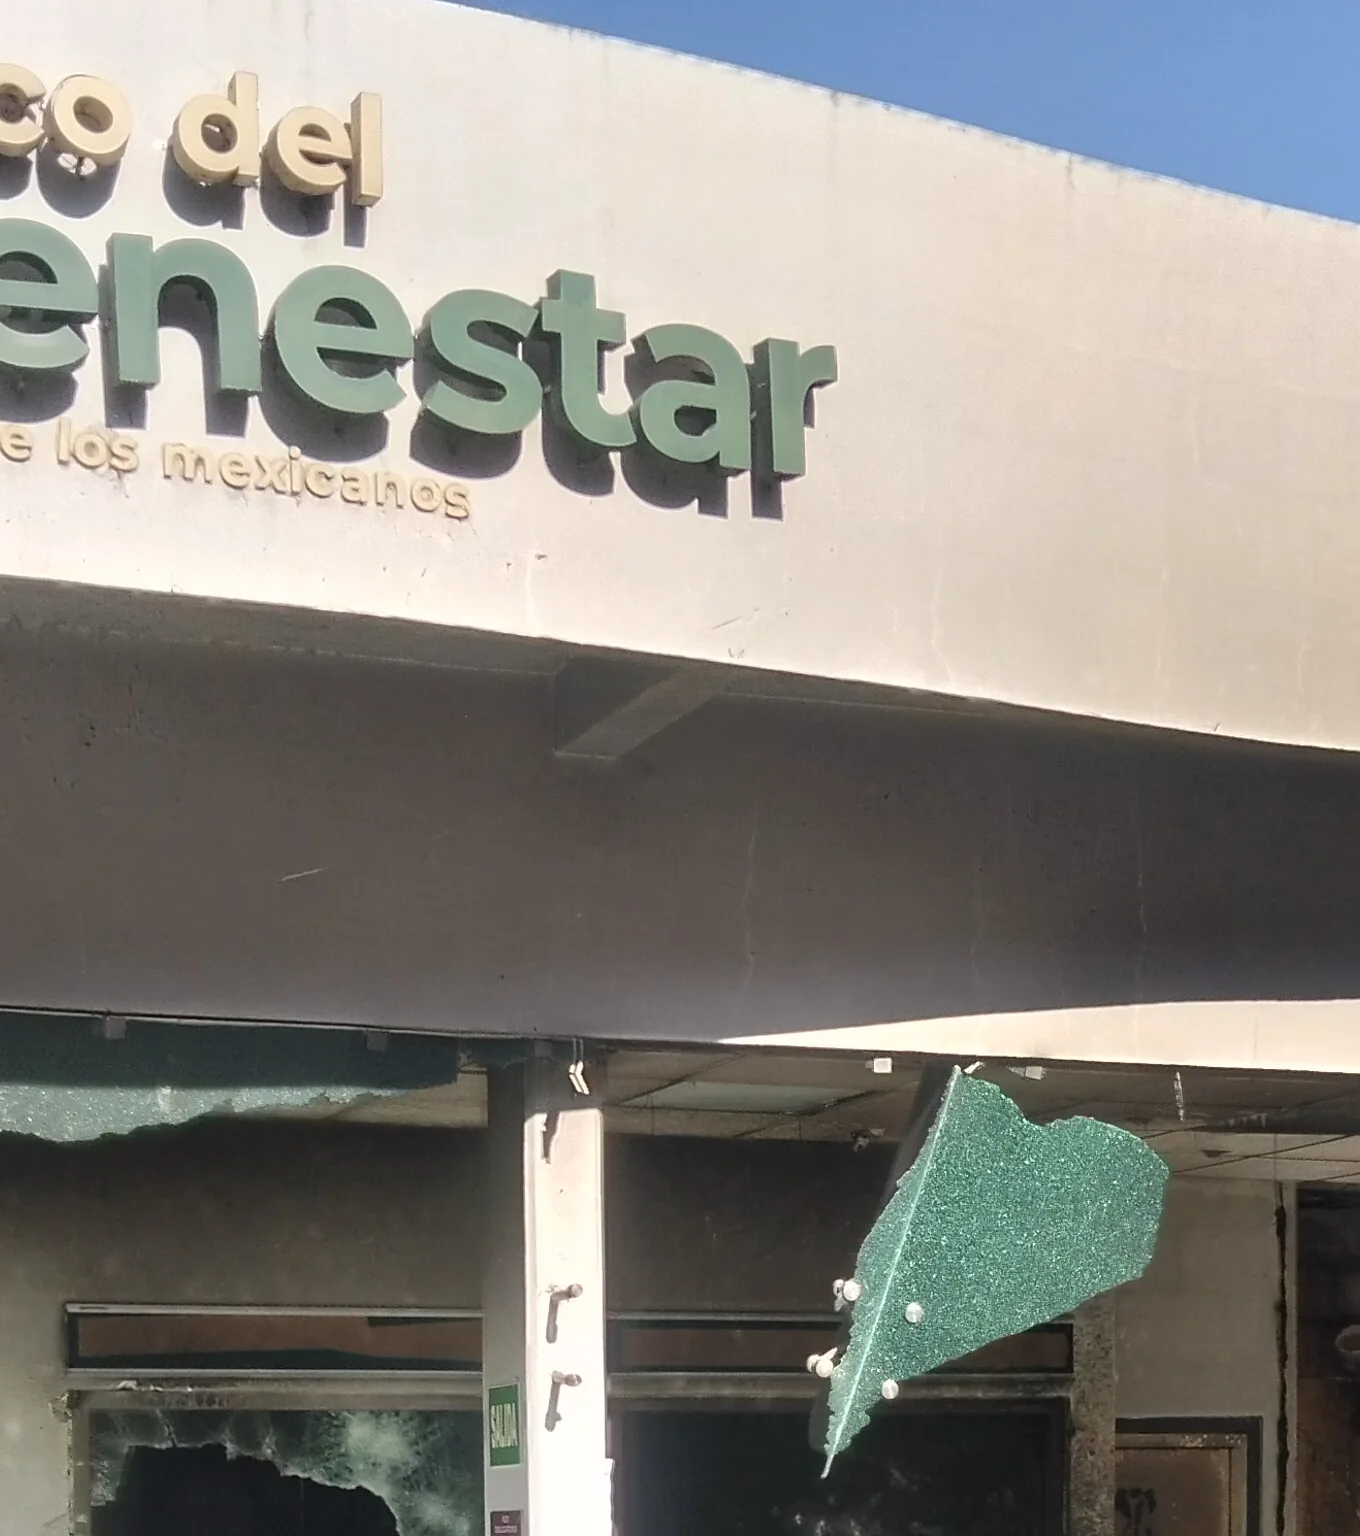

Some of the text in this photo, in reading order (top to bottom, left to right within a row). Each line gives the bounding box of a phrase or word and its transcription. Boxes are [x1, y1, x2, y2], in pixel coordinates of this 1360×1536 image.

[172, 71, 383, 206] del
[54, 417, 138, 473] los
[162, 442, 471, 520] mexicanos
